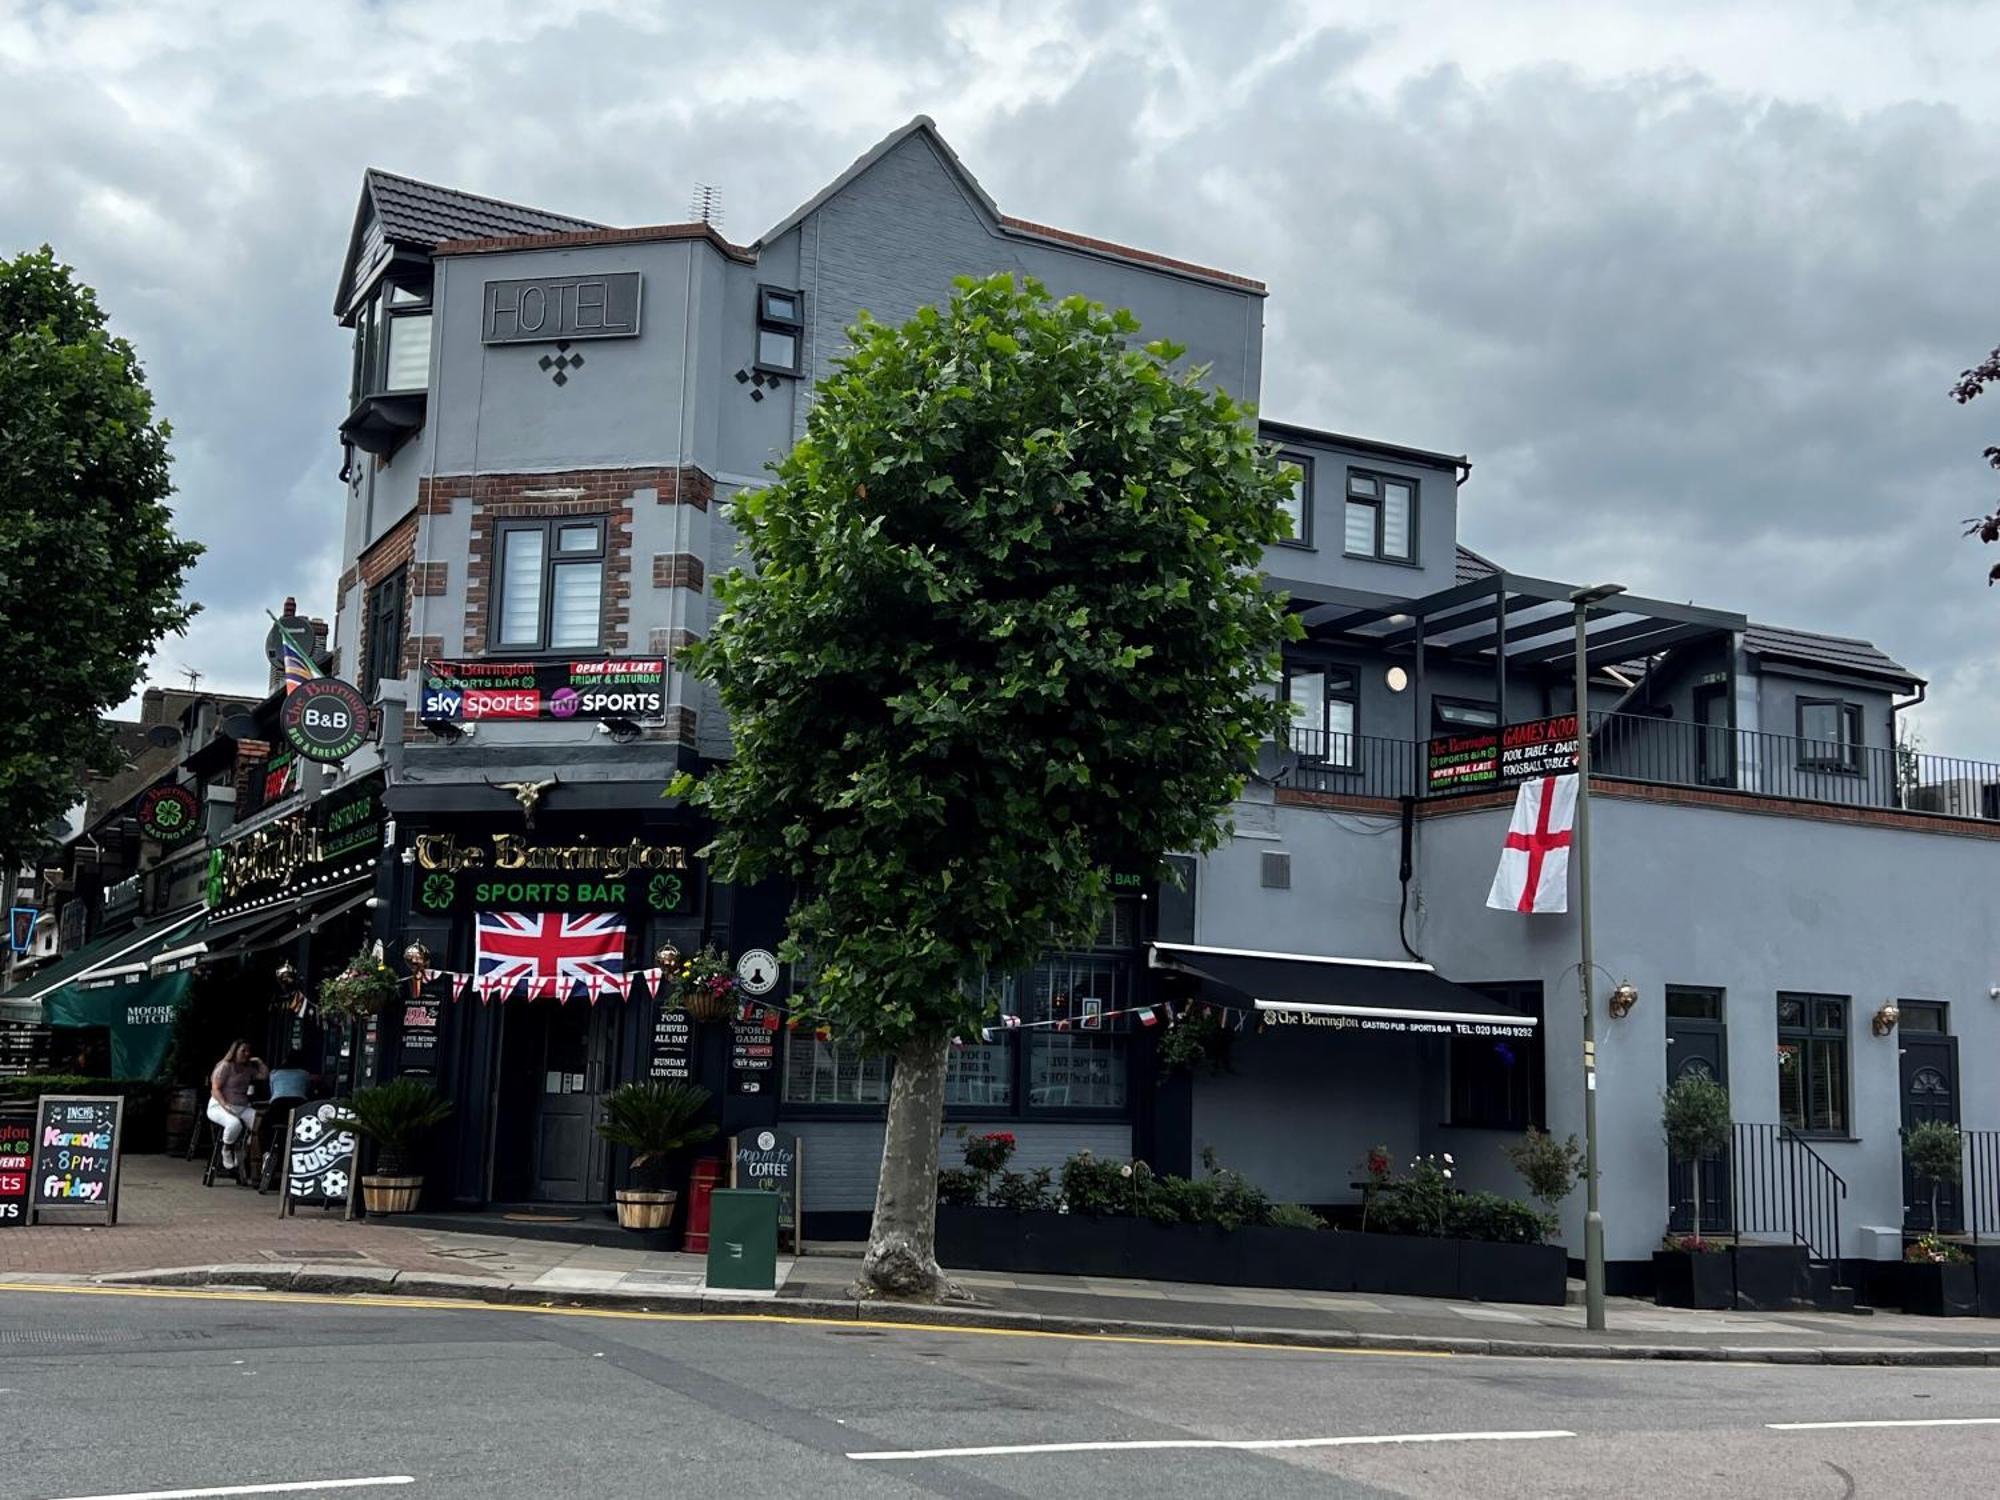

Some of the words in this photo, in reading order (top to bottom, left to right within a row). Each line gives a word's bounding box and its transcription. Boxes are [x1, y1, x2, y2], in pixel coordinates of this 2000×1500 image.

[490, 282, 629, 337] HOTEL
[461, 663, 536, 677] Barrington
[575, 663, 604, 674] OPEN
[605, 662, 629, 673] TILL
[630, 662, 658, 672] LATE
[444, 679, 492, 690] SPORTS
[495, 678, 520, 688] BAR
[570, 674, 602, 685] FRIDAY
[614, 673, 662, 684] SATURDAY
[427, 692, 461, 717] sky
[467, 693, 535, 718] sports
[582, 693, 661, 712] SPORTS
[305, 709, 348, 728] B&B
[1503, 720, 1545, 746] GAMES
[288, 727, 304, 745] BED
[311, 733, 362, 758] BREAKFAST
[1439, 753, 1469, 765] SPORTS
[1470, 750, 1487, 760] BAR
[1502, 749, 1522, 763] POOL
[1524, 743, 1547, 759] TABLE
[1433, 767, 1453, 778] OPEN
[1455, 764, 1472, 774] TILL
[1473, 760, 1492, 770] LATE
[1503, 762, 1543, 777] FOOSBALL
[1543, 757, 1569, 770] TABLE
[416, 833, 484, 873] The
[492, 833, 689, 880] Barrington
[1115, 873, 1141, 886] BAR
[476, 884, 570, 903] SPORTS
[577, 884, 626, 903] BAR
[661, 1014, 685, 1022] FOOD
[1278, 1010, 1299, 1025] The
[1301, 1010, 1359, 1030] Barrington
[1361, 1020, 1389, 1030] GASTRO
[1391, 1022, 1405, 1031] PUB
[1410, 1023, 1436, 1033] SPORTS
[1437, 1025, 1451, 1033] BAR
[1475, 1025, 1490, 1036] 020
[1492, 1026, 1511, 1036] 8449
[656, 1024, 688, 1033] SERVED
[734, 1026, 773, 1035] SPORTS
[654, 1035, 670, 1043] ALL
[672, 1035, 688, 1043] DAY
[735, 1035, 771, 1044] GAMES
[653, 1058, 686, 1066] SUNDAY
[650, 1068, 688, 1077] LUNCHES
[43, 1126, 111, 1149] Karaoke
[749, 1163, 788, 1177] COFFEE
